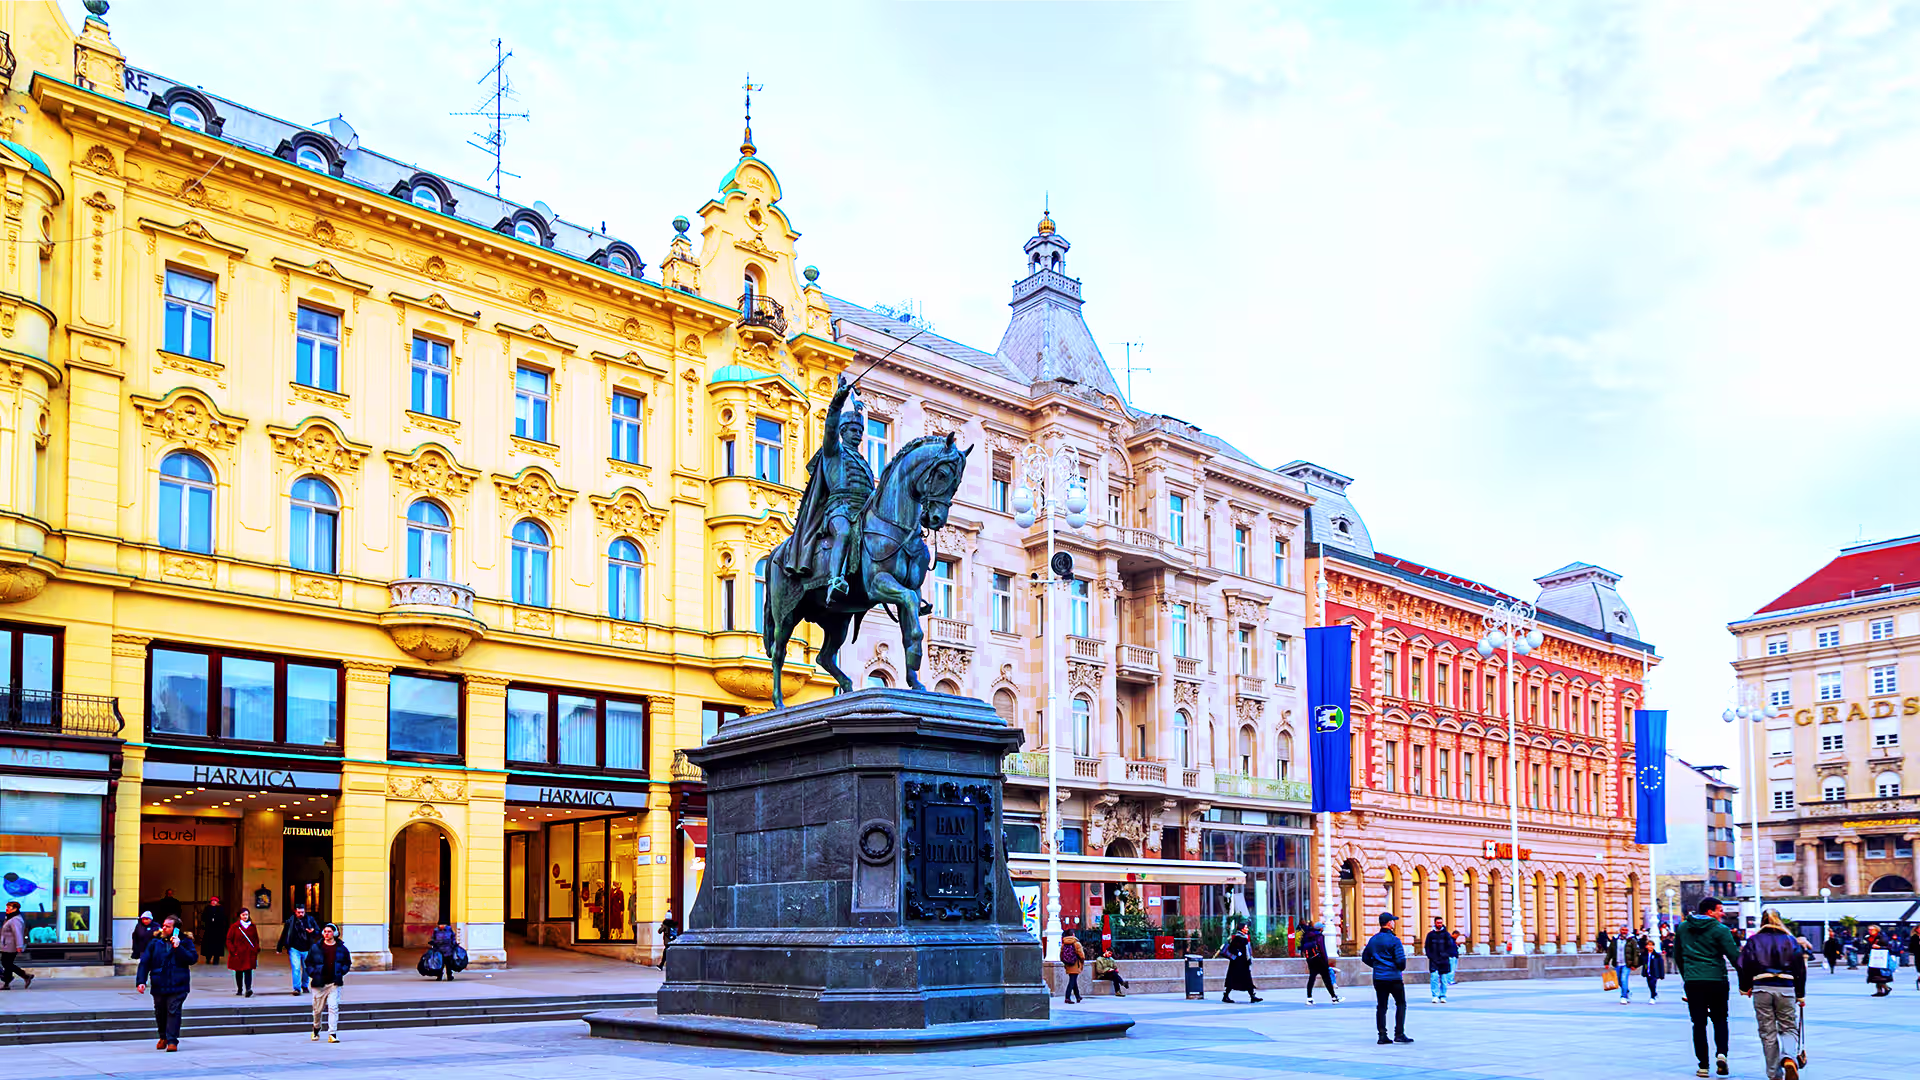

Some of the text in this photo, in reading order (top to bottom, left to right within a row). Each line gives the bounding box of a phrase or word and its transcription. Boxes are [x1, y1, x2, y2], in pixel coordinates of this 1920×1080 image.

[11, 749, 65, 768] Mala
[194, 766, 296, 788] HARMICA
[539, 788, 615, 806] HARMICA
[153, 827, 196, 841] Laurèl
[936, 816, 967, 836] BAN
[1497, 842, 1532, 860] Müler
